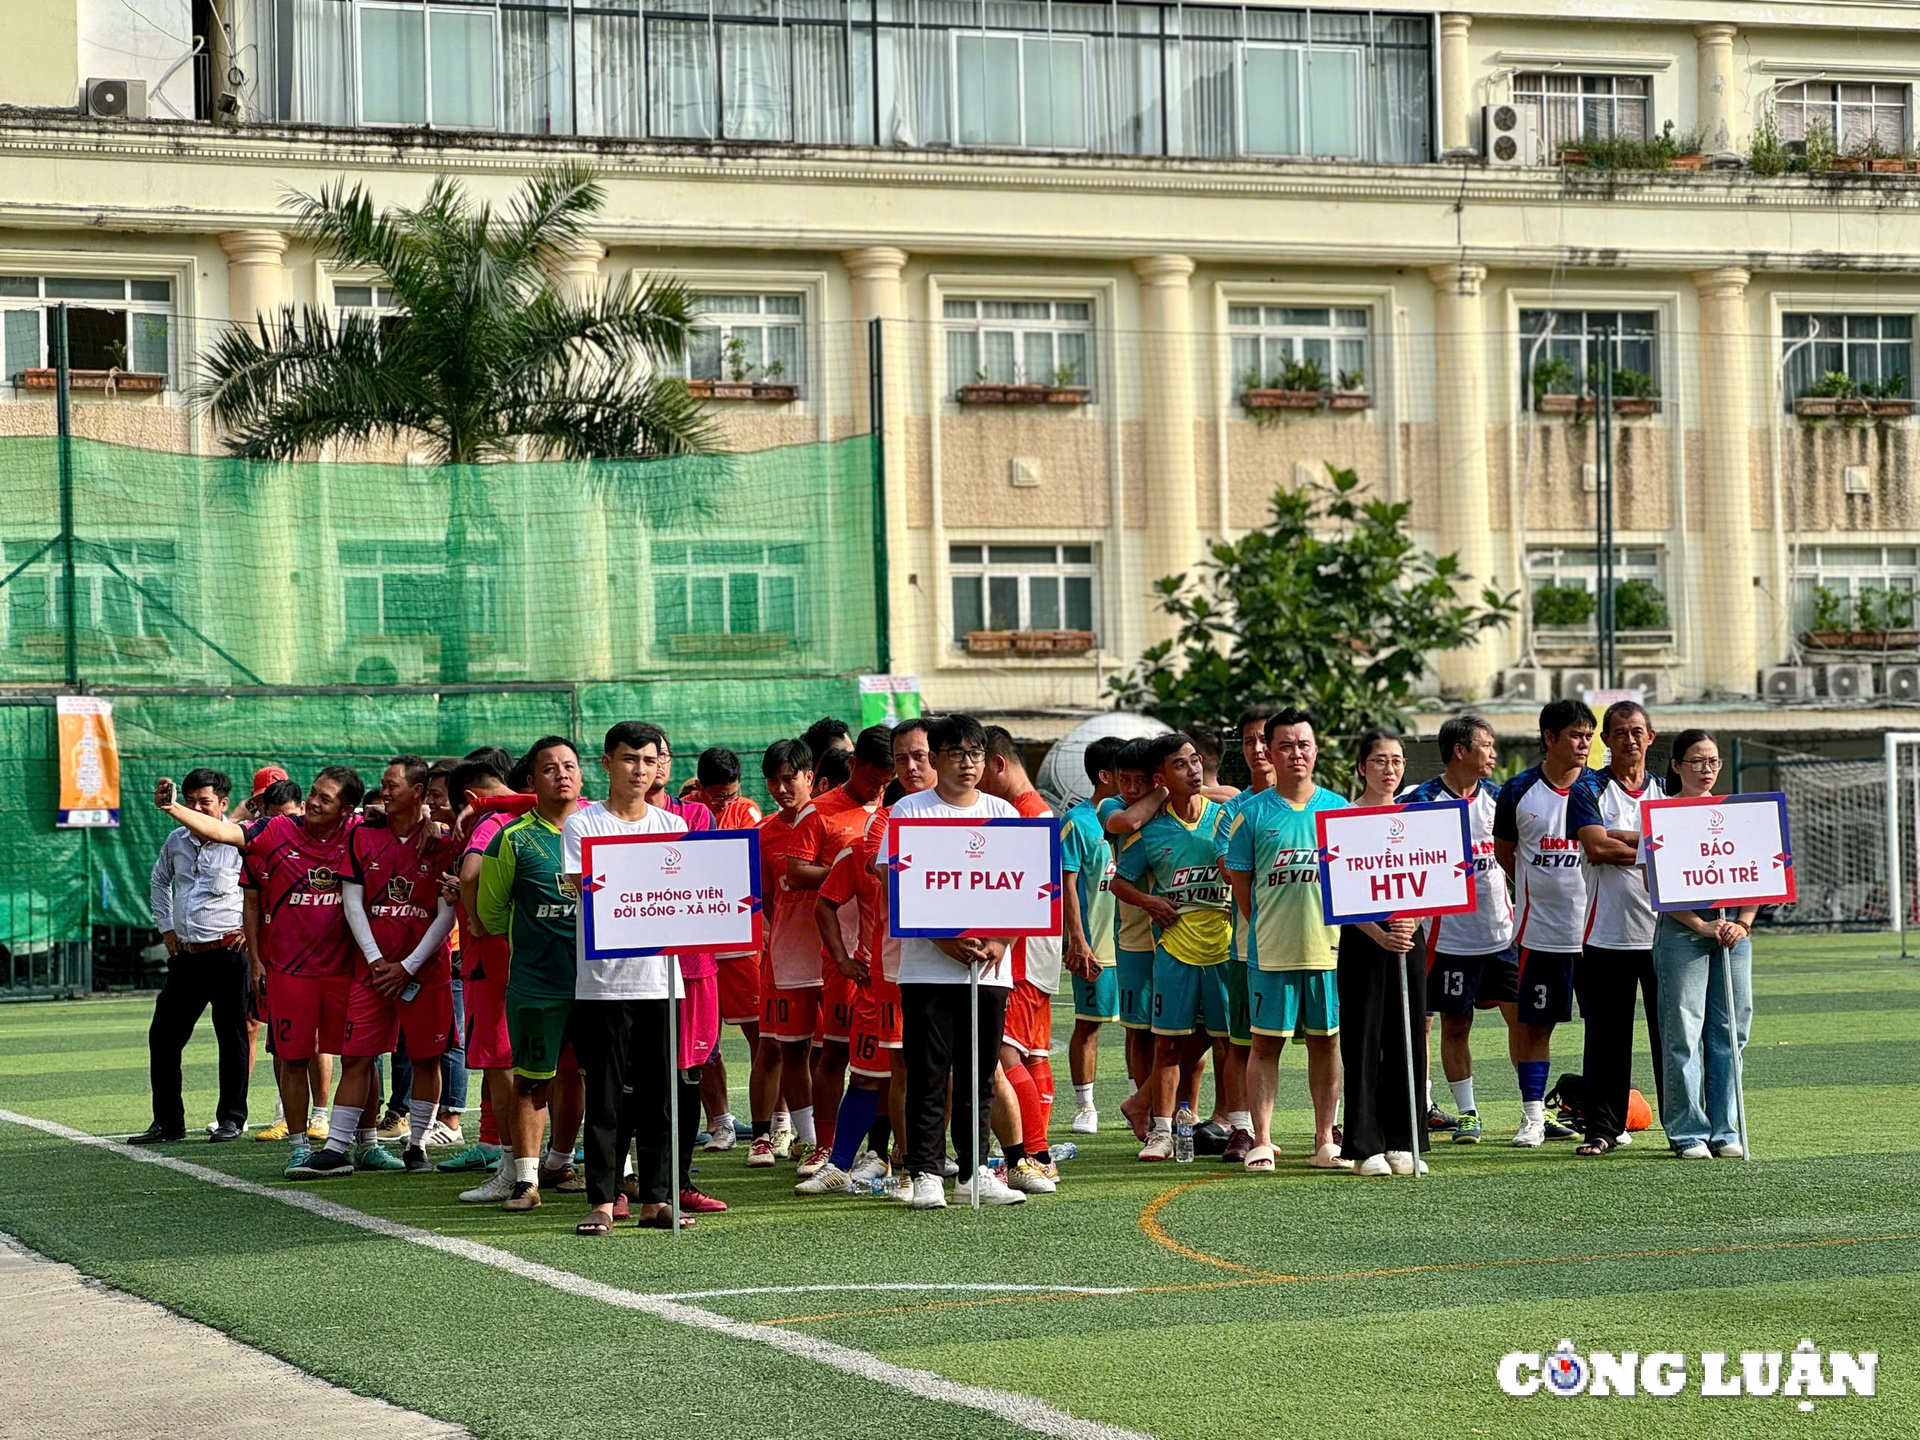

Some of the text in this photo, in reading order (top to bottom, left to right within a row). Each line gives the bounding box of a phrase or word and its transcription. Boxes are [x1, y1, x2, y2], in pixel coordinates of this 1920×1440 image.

[1700, 838, 1735, 857] BÁO
[1346, 848, 1447, 871] TRUYỀN HÌNH
[925, 871, 1025, 890] FPT PLAY
[1172, 867, 1220, 887] HTV
[1682, 860, 1760, 886] TUỔI TRẺ
[620, 886, 723, 903] CLB PHÓNG VIÊN
[1370, 871, 1428, 901] HTV
[614, 906, 636, 918] ĐỜI
[640, 898, 676, 917] SỐNG
[687, 902, 704, 915] XÃ
[708, 901, 731, 916] HỘI
[1443, 970, 1464, 996] 13
[1085, 985, 1097, 1007] 2
[1120, 988, 1133, 1014] 11
[1154, 993, 1163, 1017] 9
[1254, 991, 1263, 1018] 7
[1533, 984, 1547, 1009] 3
[881, 1001, 895, 1029] 11
[275, 1018, 291, 1041] 12
[344, 1021, 354, 1042] 9
[856, 1032, 878, 1060] 16
